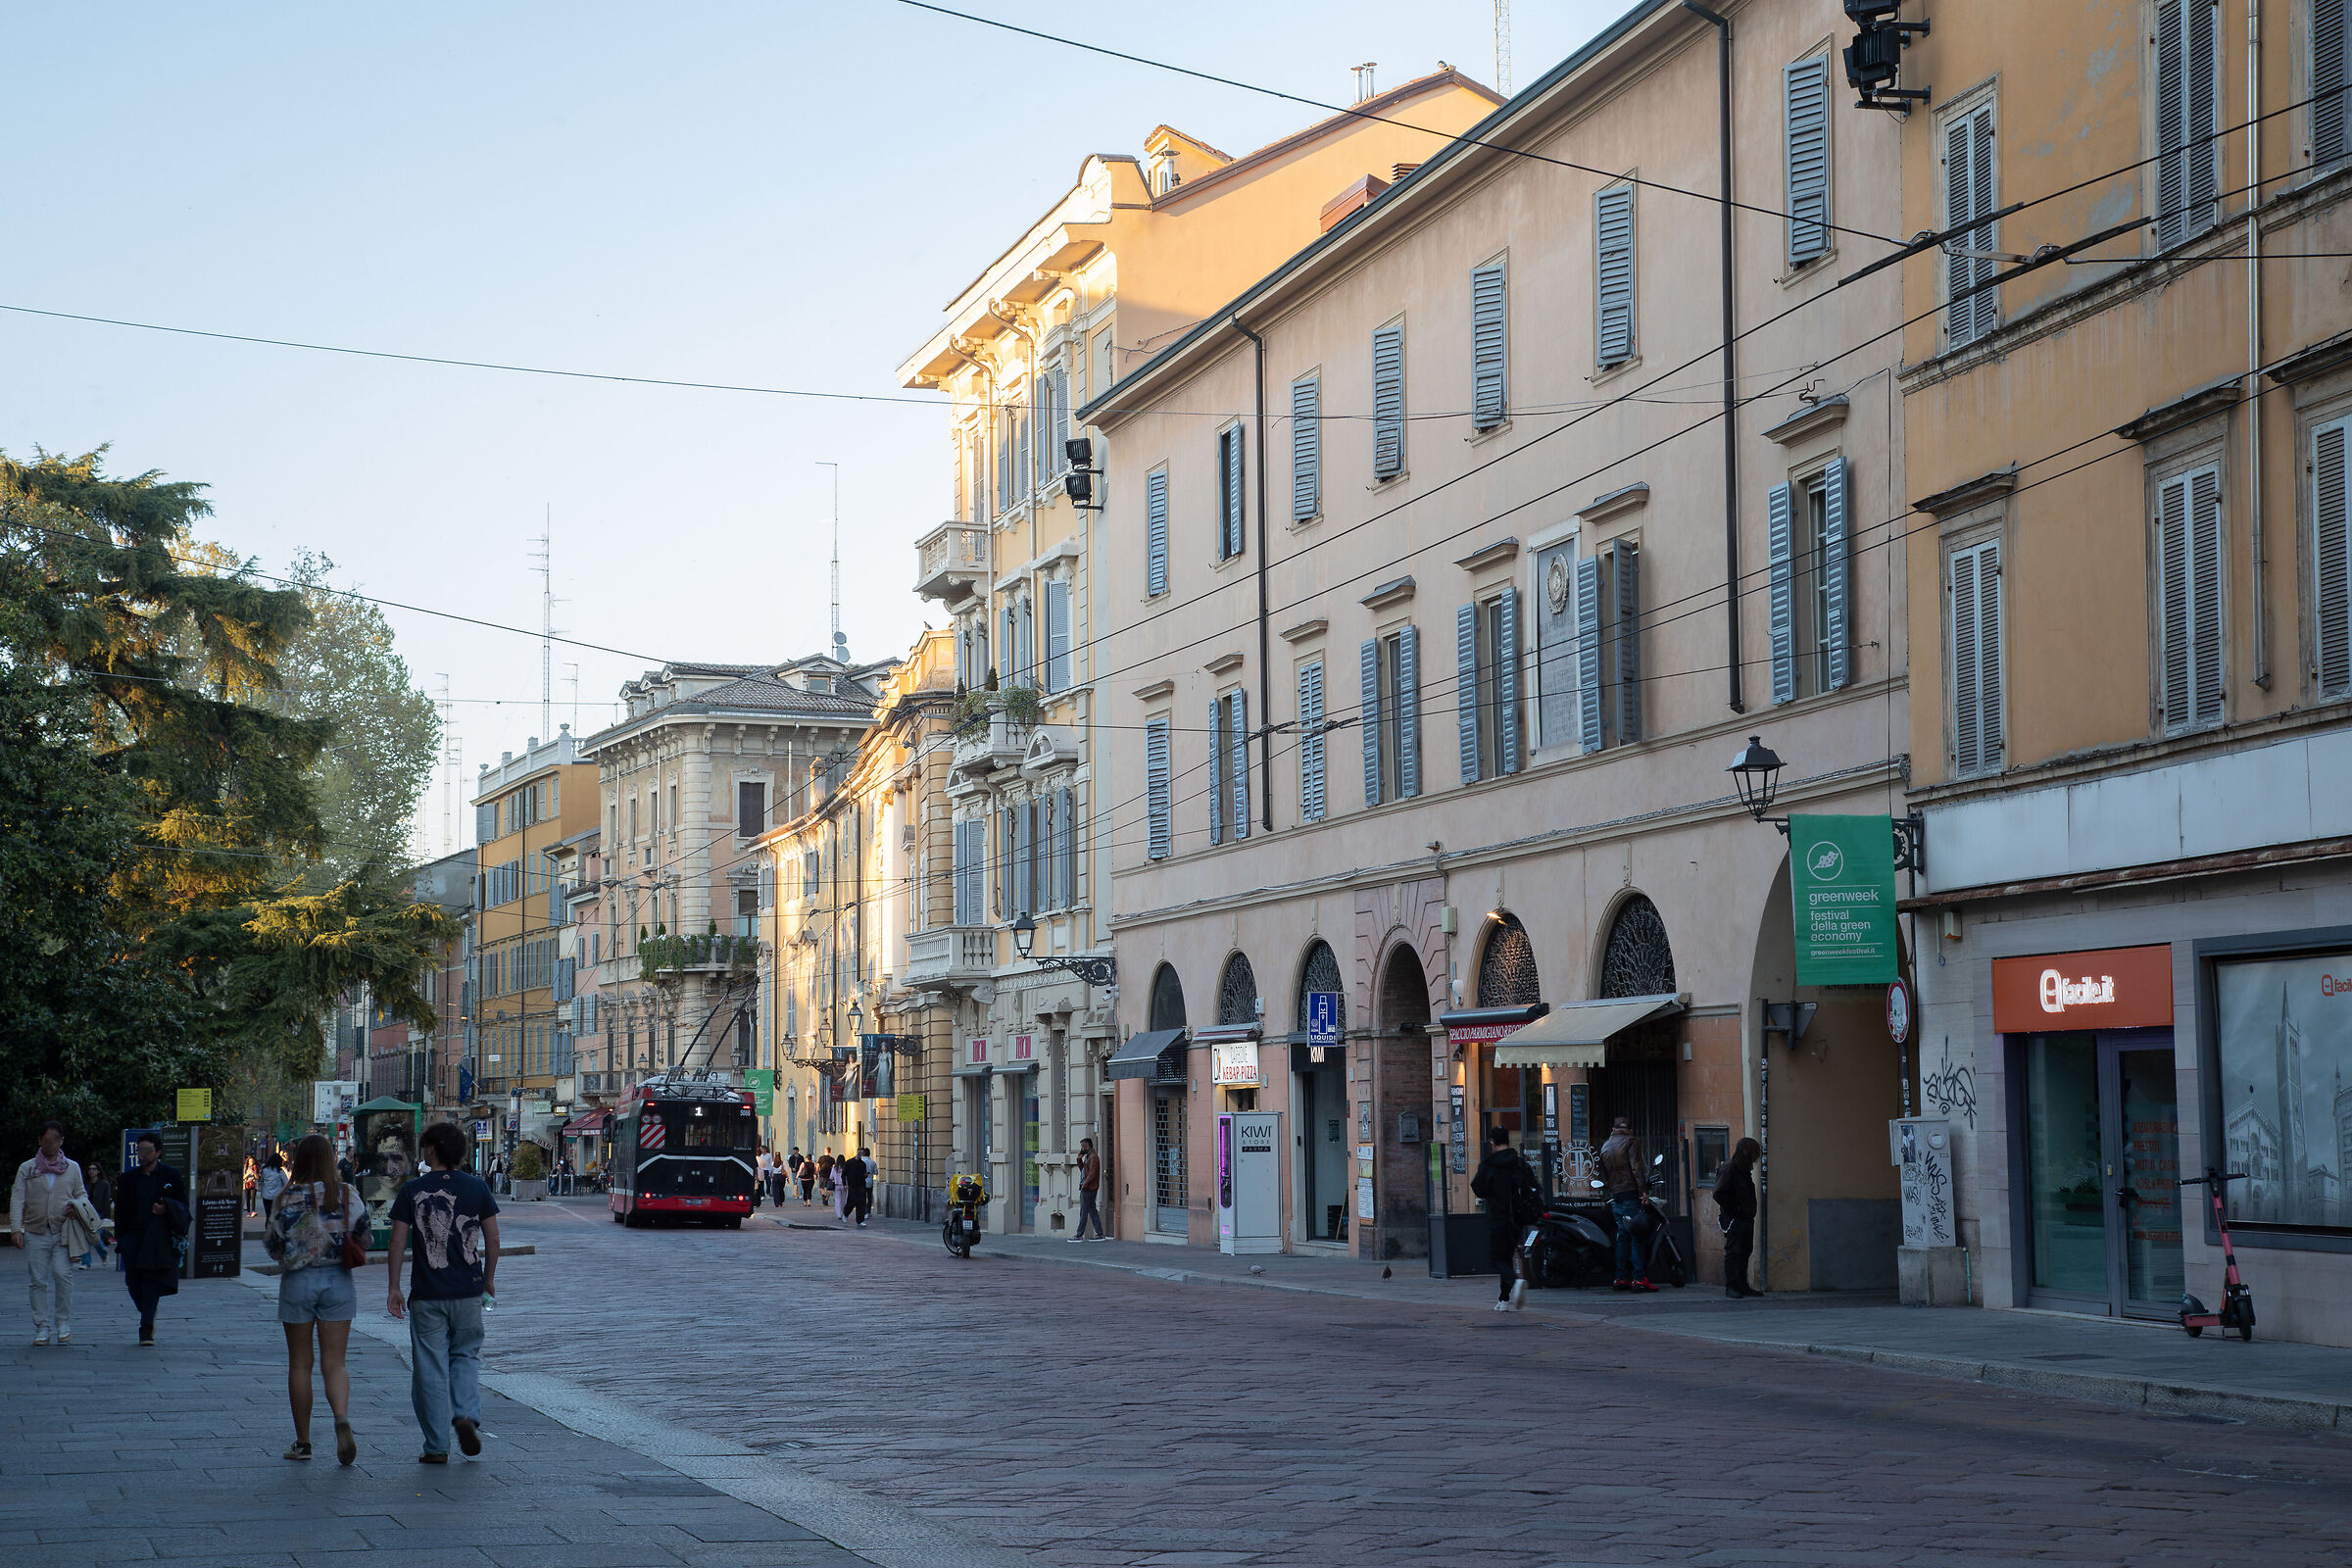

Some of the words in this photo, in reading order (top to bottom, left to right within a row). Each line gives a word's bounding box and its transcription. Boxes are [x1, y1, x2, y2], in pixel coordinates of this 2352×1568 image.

[1809, 889, 1879, 905] greenweek
[1810, 909, 1849, 920] festival
[1811, 921, 1838, 931] della
[1840, 921, 1871, 932] green
[1810, 932, 1862, 942] economy
[1810, 948, 1876, 956] greenweekfestival.it
[2062, 975, 2115, 1005] facile.it
[2334, 978, 2352, 993] facil
[1310, 1047, 1325, 1063] KIWI
[694, 1106, 704, 1116] 1
[1242, 1125, 1271, 1138] KIWI
[1556, 1140, 1600, 1163] BIRRIFICIO
